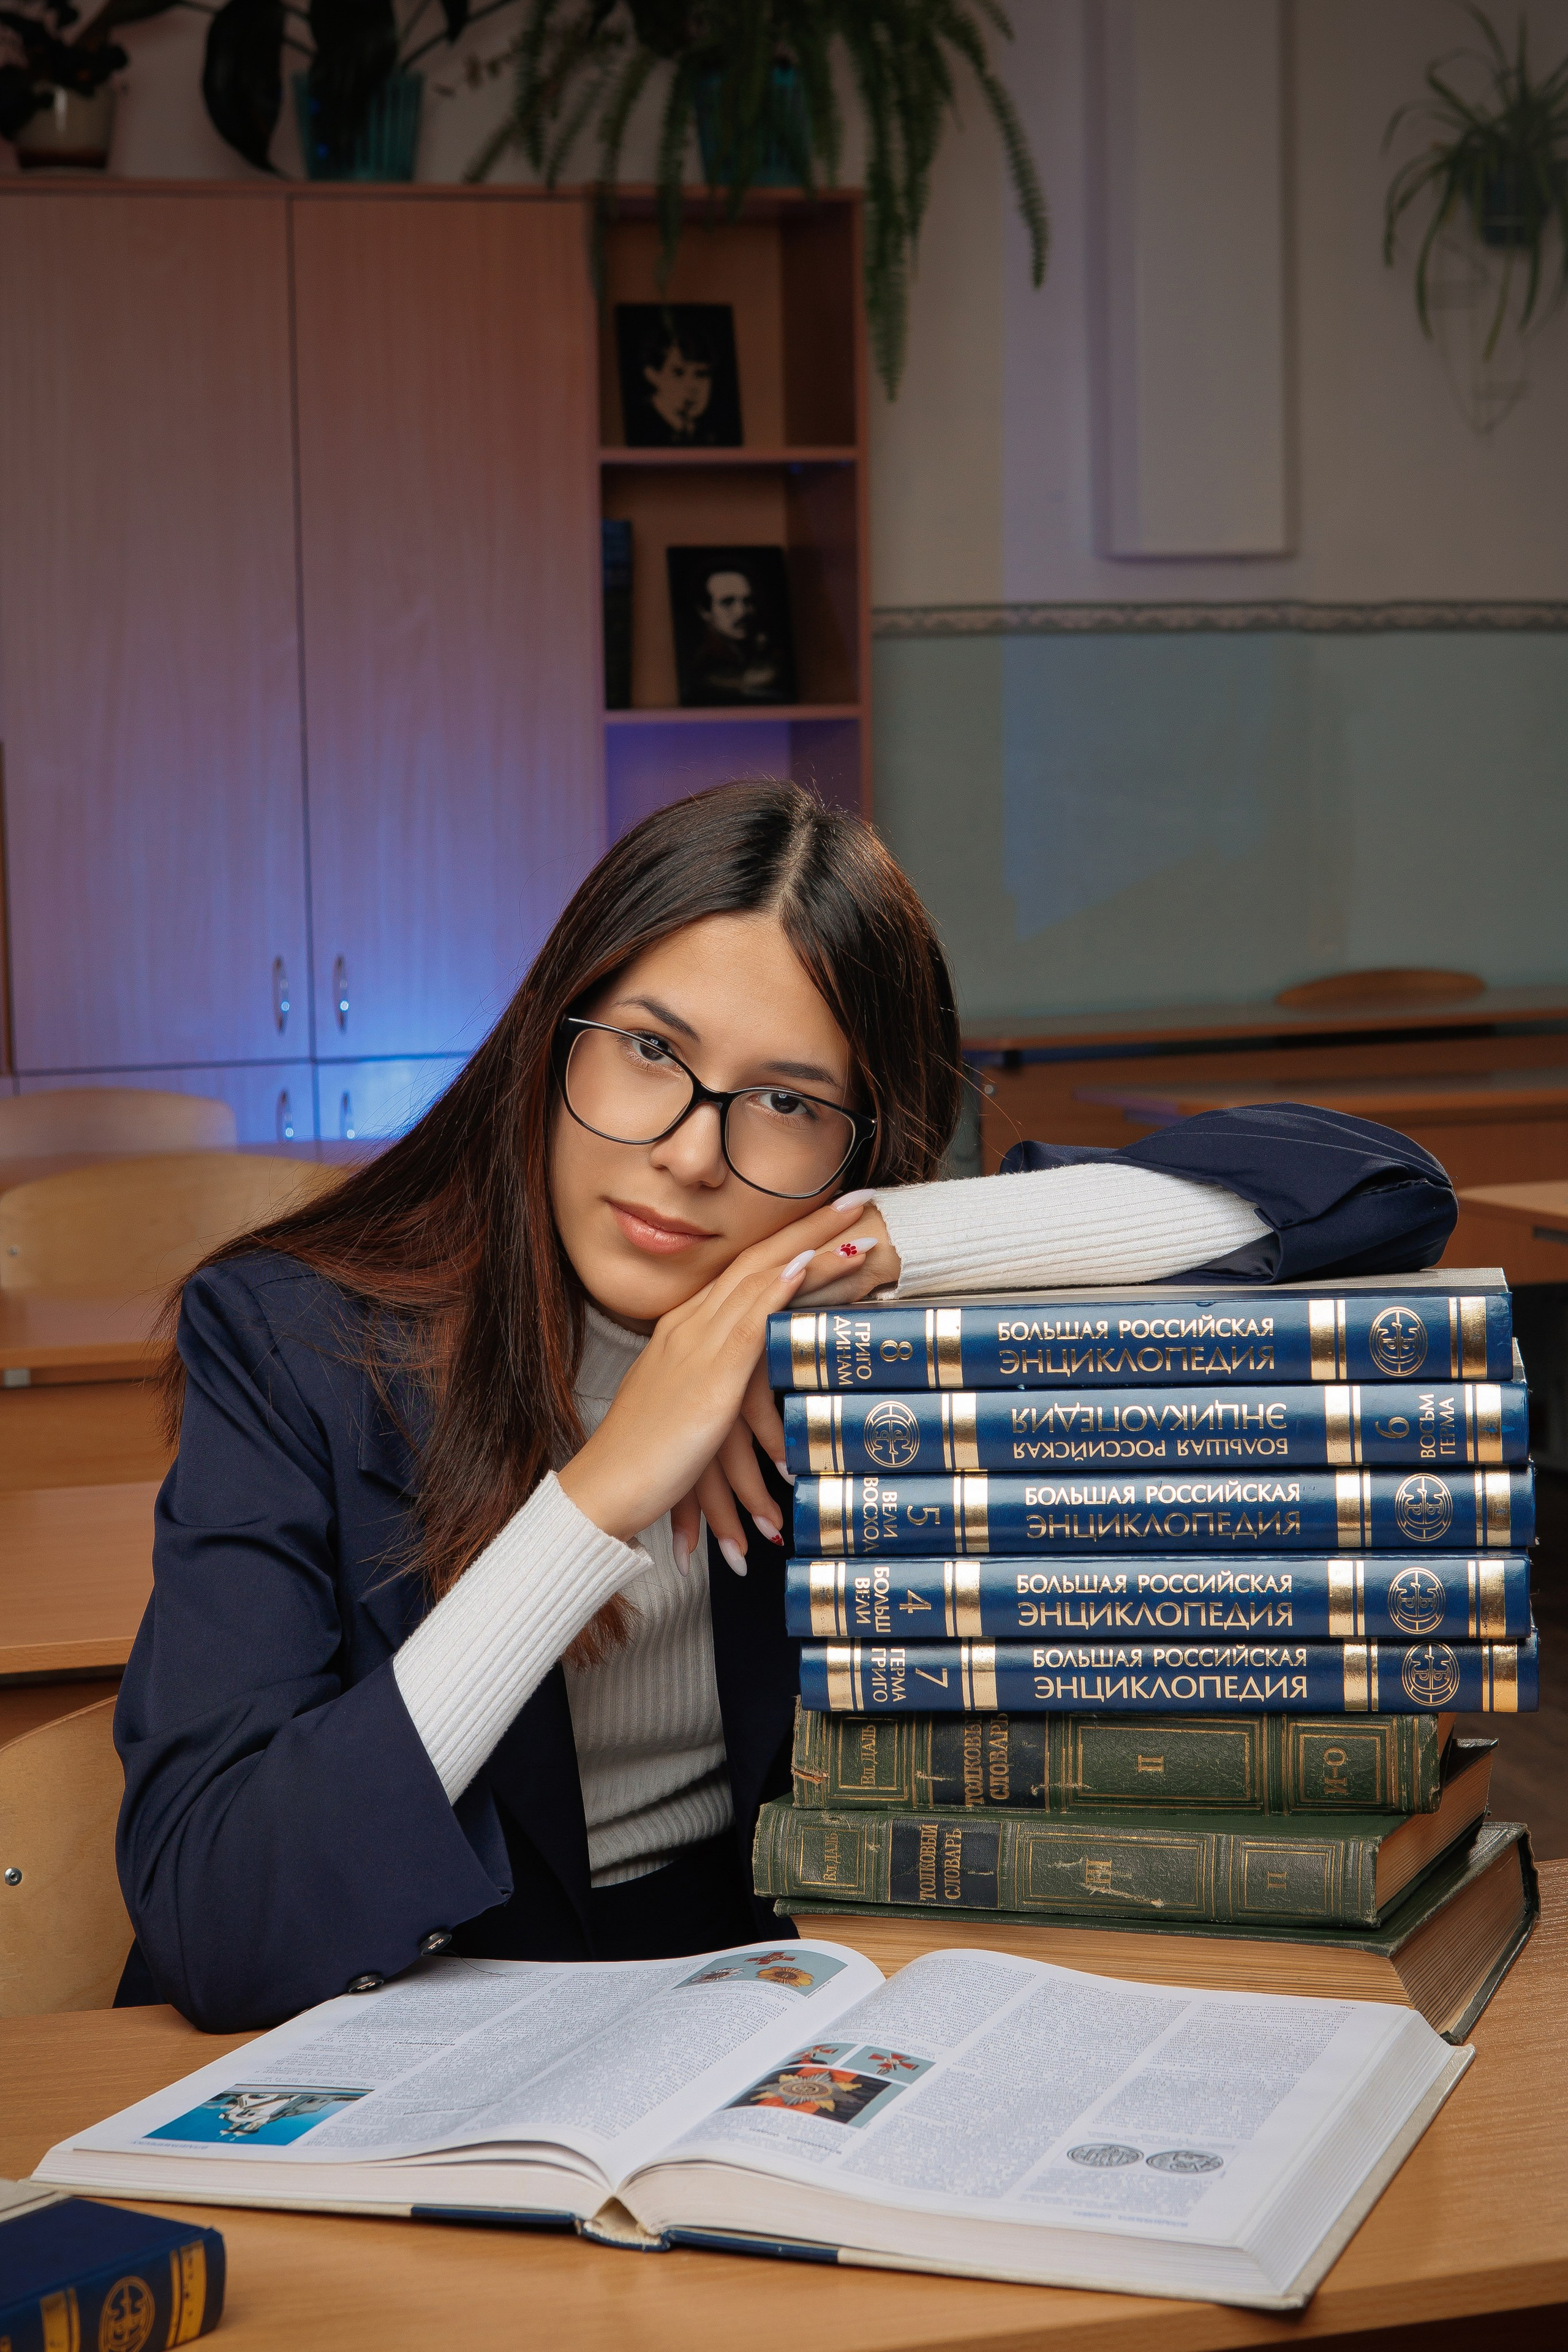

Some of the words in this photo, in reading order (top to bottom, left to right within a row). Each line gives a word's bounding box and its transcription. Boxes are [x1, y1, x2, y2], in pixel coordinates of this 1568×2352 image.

[997, 1319, 1109, 1341] БОЛЬШАЯ
[1118, 1314, 1275, 1339] РОССИЙСКАЯ
[833, 1316, 854, 1385] ДИНАМ
[854, 1322, 872, 1380] ГРИГО
[880, 1339, 913, 1362] 8
[998, 1346, 1275, 1377] ЭНЦИКЛОПЕДИЯ
[1011, 1399, 1287, 1434] ЭНЦИКЛОПЕДИЯ
[1374, 1416, 1409, 1439] 6
[1419, 1393, 1436, 1458] ВОСЬМ
[1438, 1397, 1456, 1454] ГЕРМА
[1013, 1441, 1167, 1461] РОССИЙСКАЯ
[1177, 1438, 1289, 1457] БОЛЬШАЯ
[1025, 1485, 1135, 1506] БОЛЬШАЯ
[1145, 1480, 1300, 1504] РОССИЙСКАЯ
[882, 1491, 898, 1537] ВЕЛИ
[907, 1504, 940, 1525] 5
[1026, 1511, 1300, 1542] ЭНЦИКЛОПЕДИЯ
[1016, 1573, 1127, 1594] БОЛЬШАЯ
[1137, 1569, 1292, 1594] РОССИЙСКАЯ
[855, 1577, 871, 1624] ВЕЛИ
[873, 1566, 891, 1633] БОЛЬШ
[899, 1589, 932, 1614] 4
[1017, 1601, 1293, 1631] ЭНЦИКЛОПЕДИЯ
[1032, 1648, 1143, 1668] БОЛЬШАЯ
[1153, 1645, 1307, 1668] РОССИЙСКАЯ
[871, 1648, 888, 1703] ГРИГО
[890, 1648, 907, 1702] ГЕРМА
[915, 1667, 948, 1689] 7
[1034, 1675, 1308, 1703] ЭНЦИКЛОПЕДИЯ
[963, 1713, 984, 1807] ТОЛКОВЫ
[988, 1713, 1010, 1800] СЛОВАРЬ
[918, 1823, 938, 1901] ТОЛКОВЫЙ
[944, 1828, 962, 1899] СЛОВАРЬ
